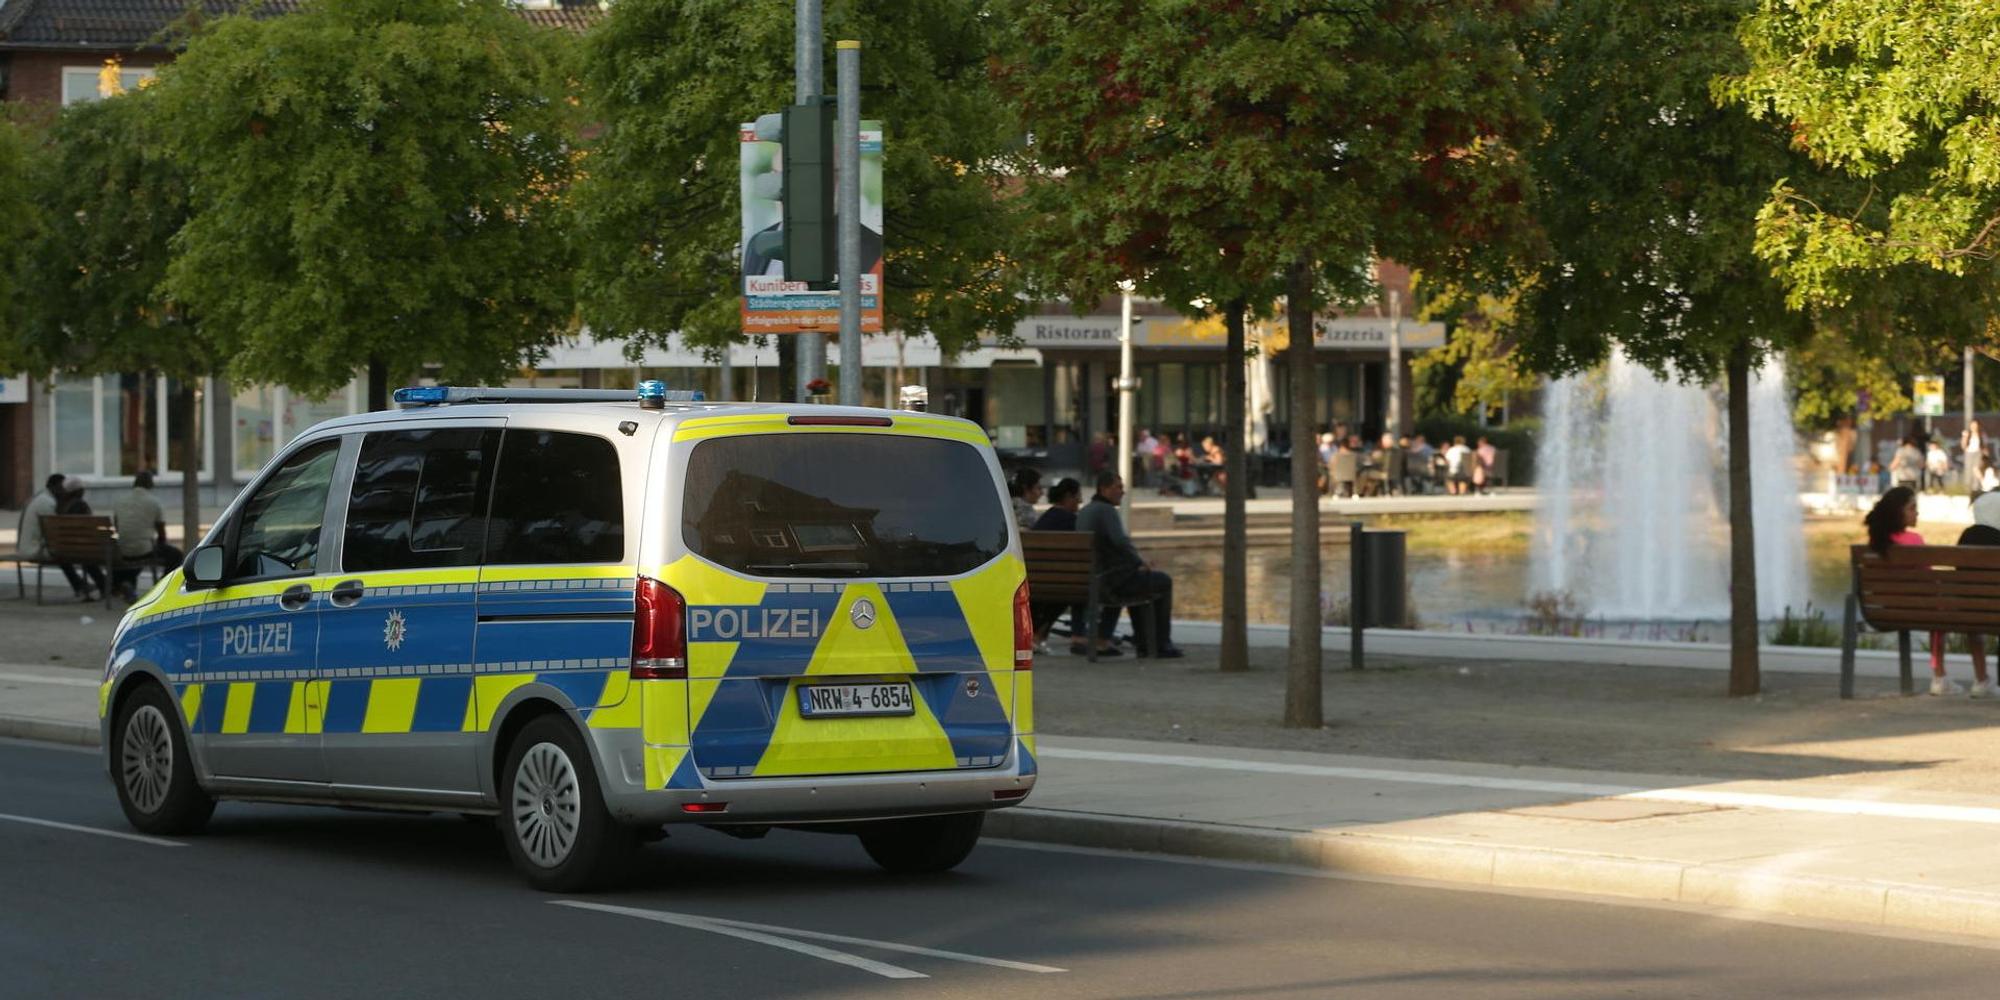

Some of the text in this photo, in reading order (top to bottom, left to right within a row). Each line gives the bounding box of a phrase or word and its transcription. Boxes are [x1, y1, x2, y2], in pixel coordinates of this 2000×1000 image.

[1036, 325, 1384, 340] Ristoran izzeria
[691, 609, 818, 638] POLIZEI
[222, 622, 292, 655] POLIZEI
[810, 686, 911, 710] NRW 4-6854
